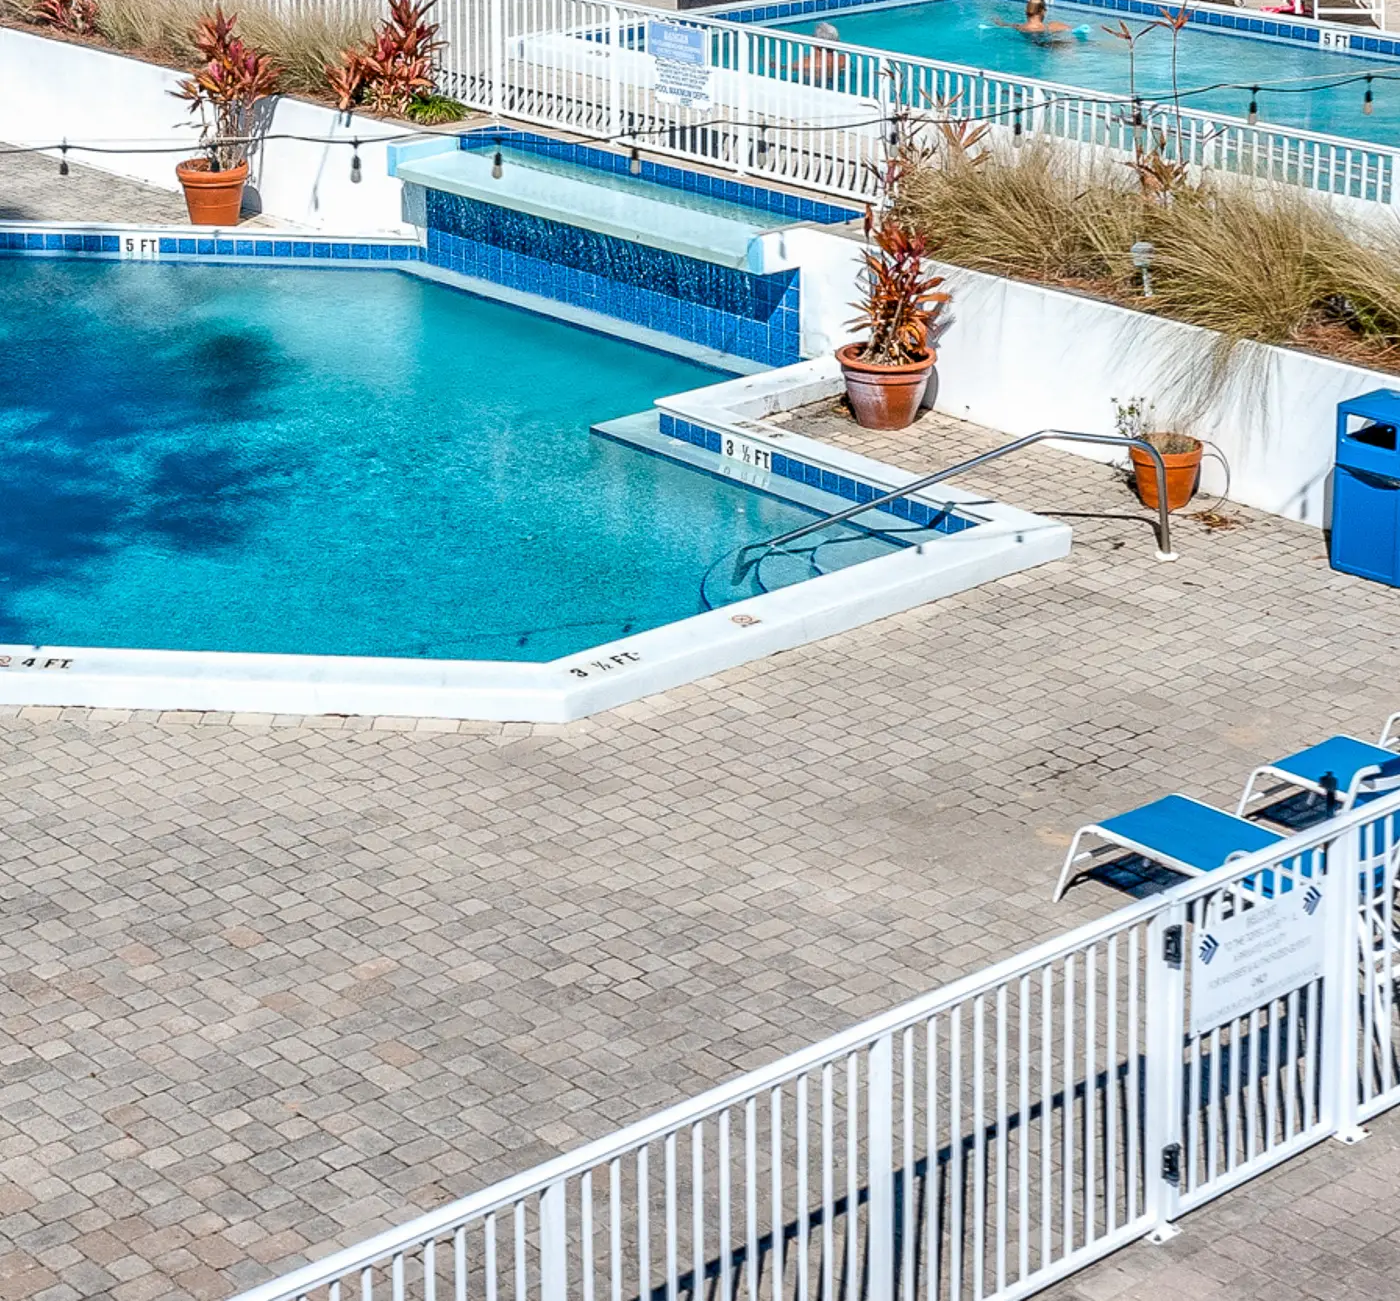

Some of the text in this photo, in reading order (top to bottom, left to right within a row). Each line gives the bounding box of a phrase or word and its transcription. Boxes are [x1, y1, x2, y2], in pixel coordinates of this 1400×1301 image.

[1324, 33, 1348, 47] 5 FT
[126, 238, 134, 252] 5
[726, 439, 734, 456] 3
[21, 657, 36, 667] 4
[569, 667, 588, 678] 3
